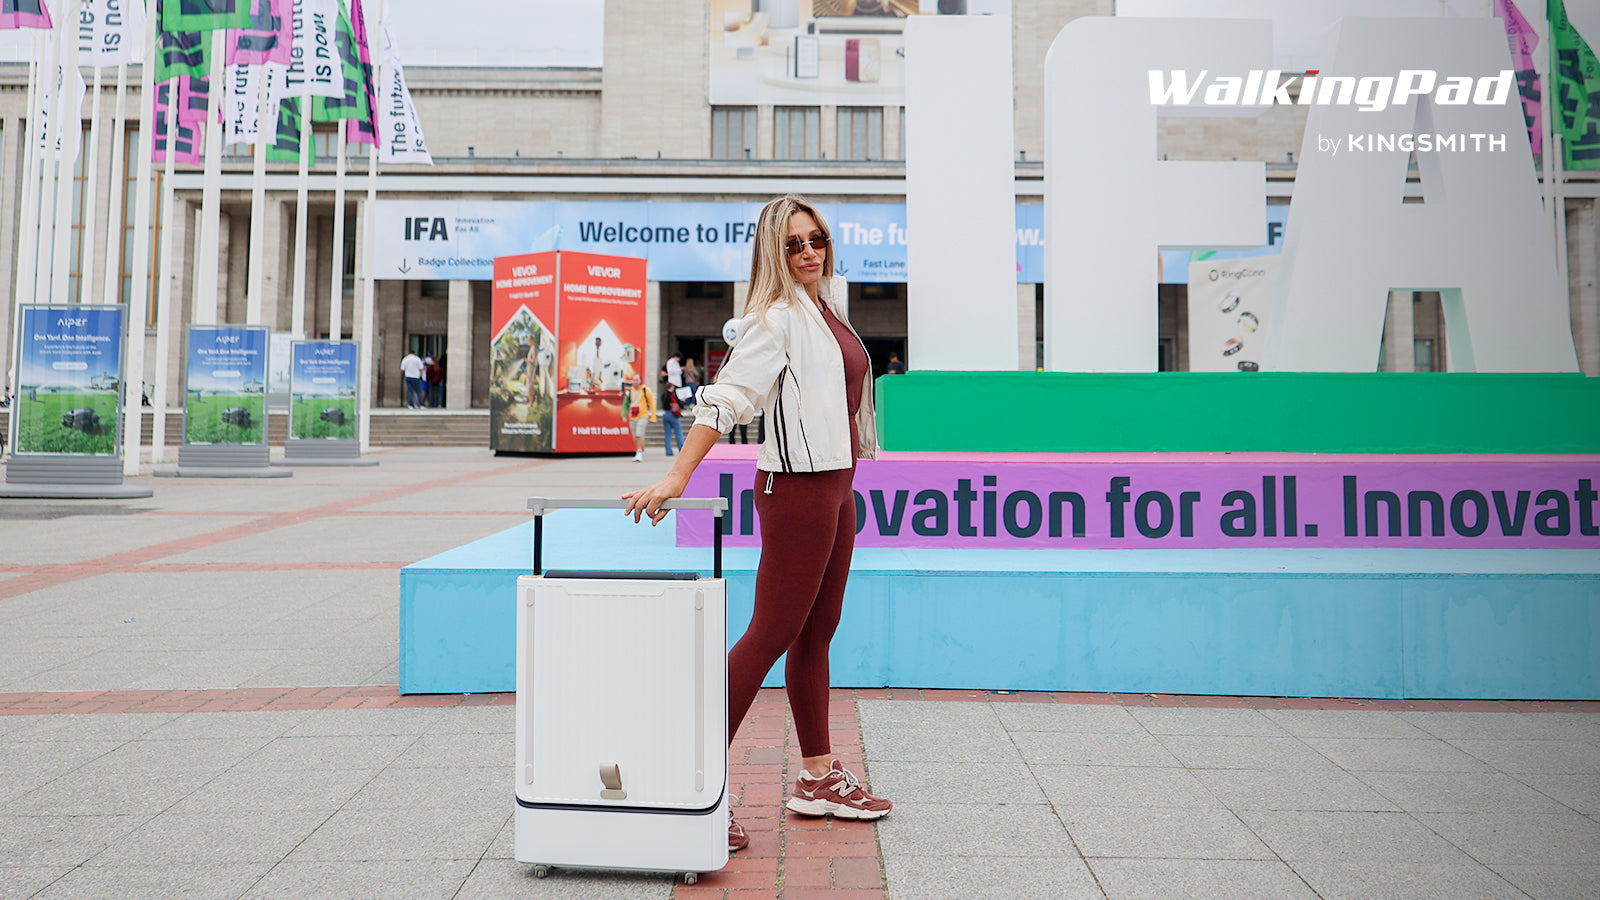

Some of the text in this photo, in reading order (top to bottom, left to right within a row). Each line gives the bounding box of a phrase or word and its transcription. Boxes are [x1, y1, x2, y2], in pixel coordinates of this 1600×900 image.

[102, 33, 122, 52] is
[286, 46, 304, 88] The
[310, 65, 332, 83] is
[391, 122, 408, 156] The
[405, 217, 448, 241] IFA
[579, 221, 690, 243] Welcome
[696, 223, 719, 243] to
[839, 222, 883, 246] The
[418, 257, 494, 268] Badge Collection
[512, 265, 537, 278] VEVOR
[587, 265, 621, 279] VEVOR
[863, 259, 905, 269] Fast Lane
[563, 283, 642, 298] HOME IMPROVEMENT
[719, 472, 1600, 539] Ivation for all. Innovat
